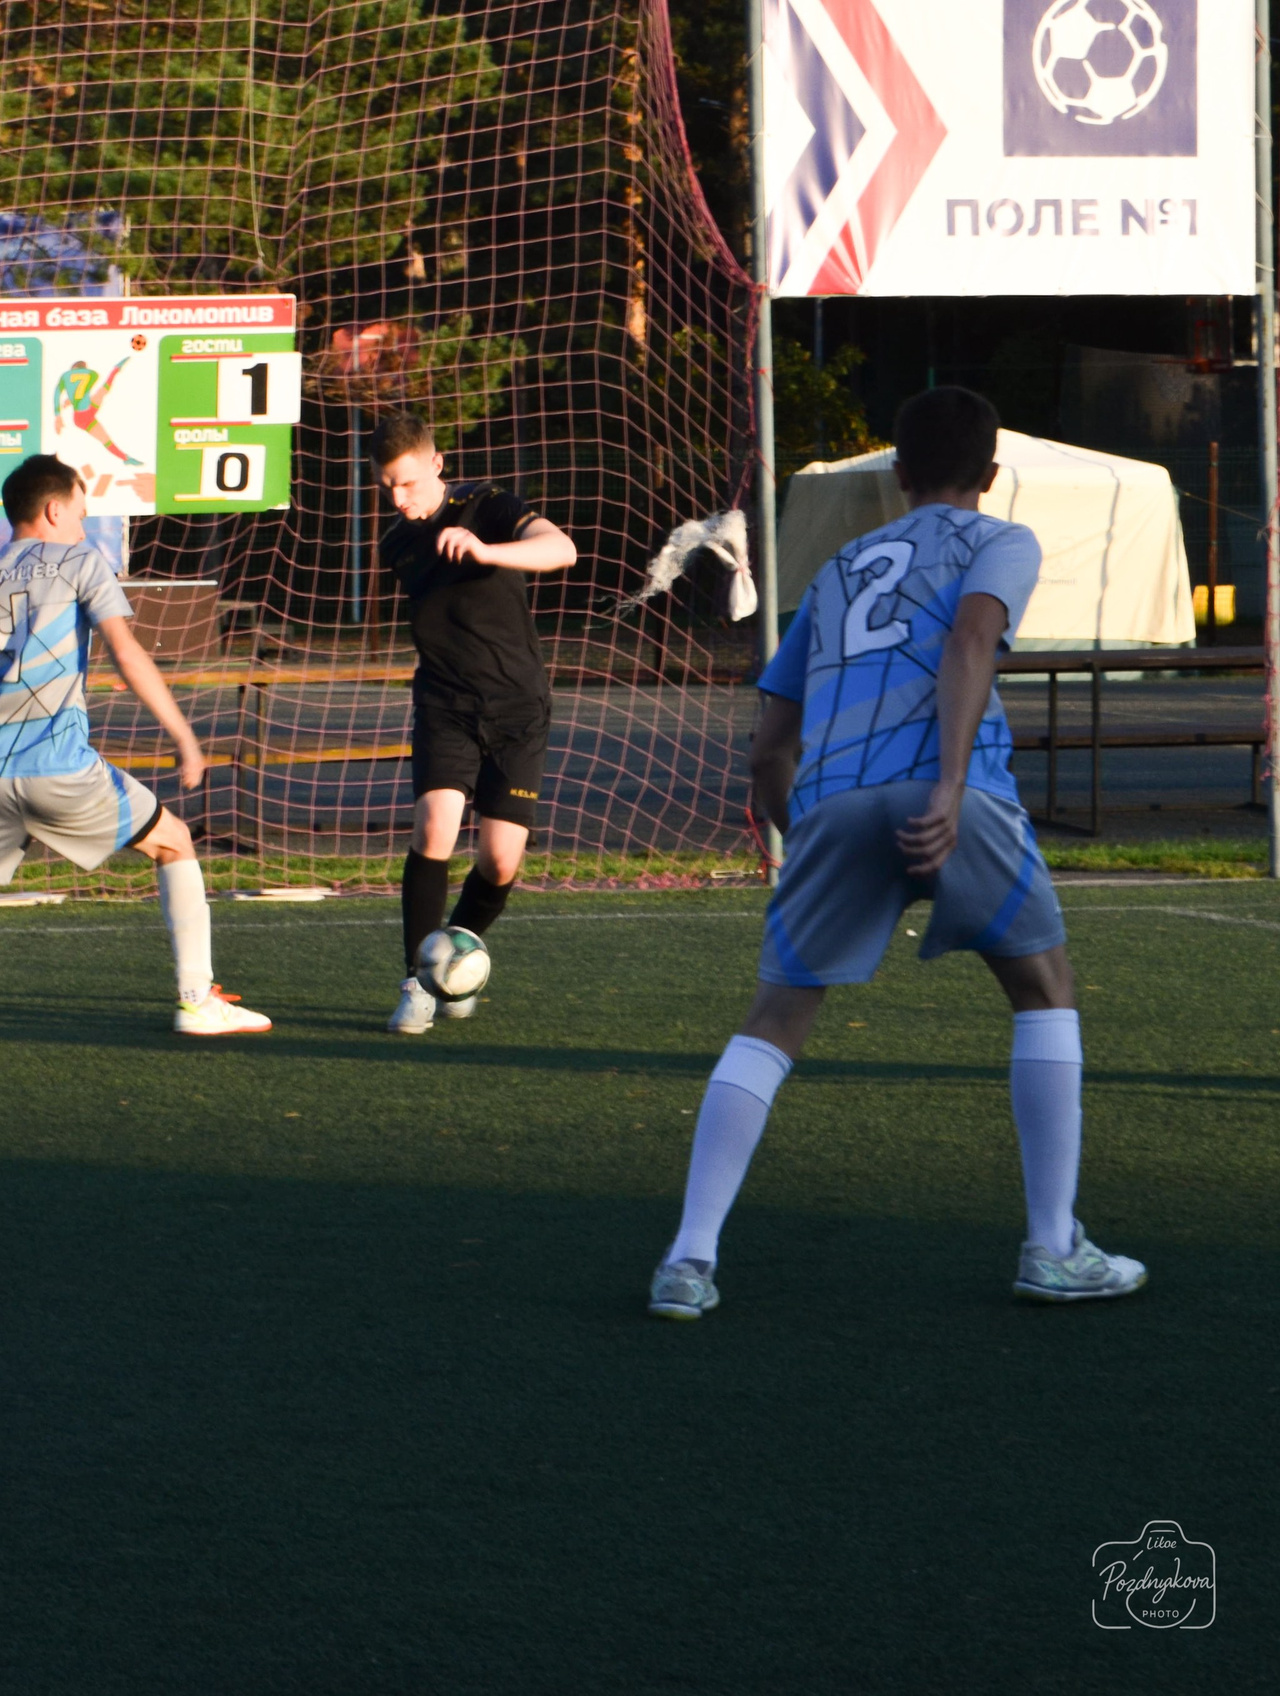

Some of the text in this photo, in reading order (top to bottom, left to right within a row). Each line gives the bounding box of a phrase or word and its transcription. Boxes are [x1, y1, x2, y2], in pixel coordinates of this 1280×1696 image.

[946, 198, 1100, 236] ПОЛЕ
[45, 307, 109, 327] база
[119, 306, 274, 326] Локомотив
[181, 338, 243, 354] гости
[70, 372, 91, 400] 7
[242, 362, 268, 415] 1
[174, 428, 228, 444] фолы
[216, 452, 250, 492] 0
[842, 539, 918, 660] 2
